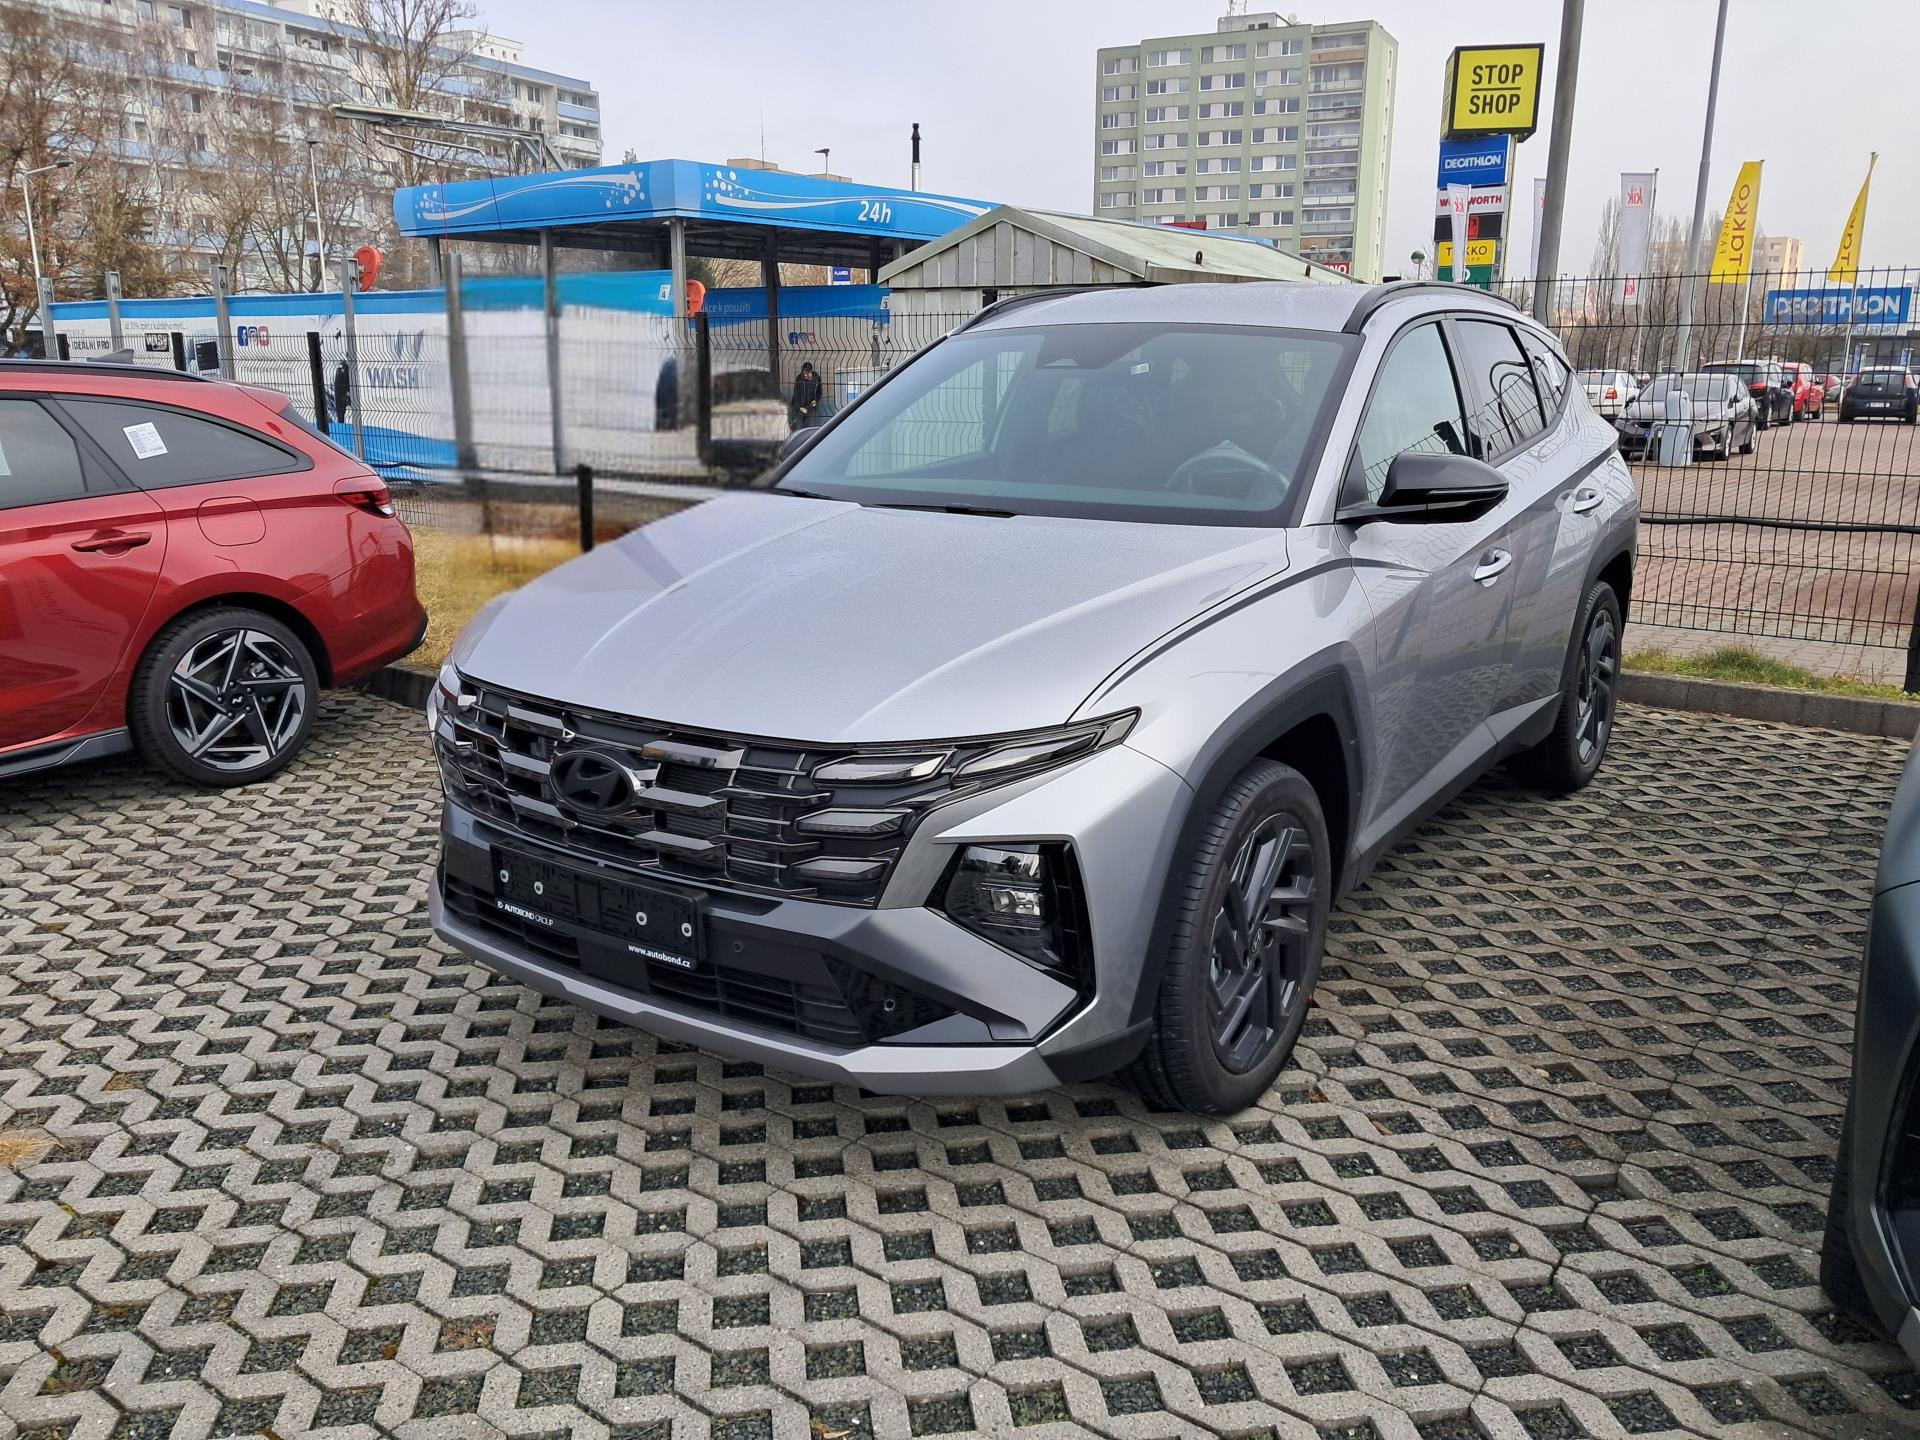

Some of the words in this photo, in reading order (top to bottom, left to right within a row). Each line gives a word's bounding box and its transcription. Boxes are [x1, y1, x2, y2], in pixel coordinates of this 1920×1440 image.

[1472, 64, 1524, 85] STOP
[1469, 94, 1520, 114] SHOP
[1445, 155, 1501, 169] DECATHLON
[1440, 195, 1502, 207] WWORTH
[858, 200, 892, 224] 24h
[883, 301, 888, 309] 3
[1773, 295, 1901, 316] DECATHLON
[367, 367, 419, 389] WASH
[504, 903, 535, 920] AUTOBOND
[535, 914, 554, 926] GROUP
[627, 944, 691, 968] www.autobond.cz
